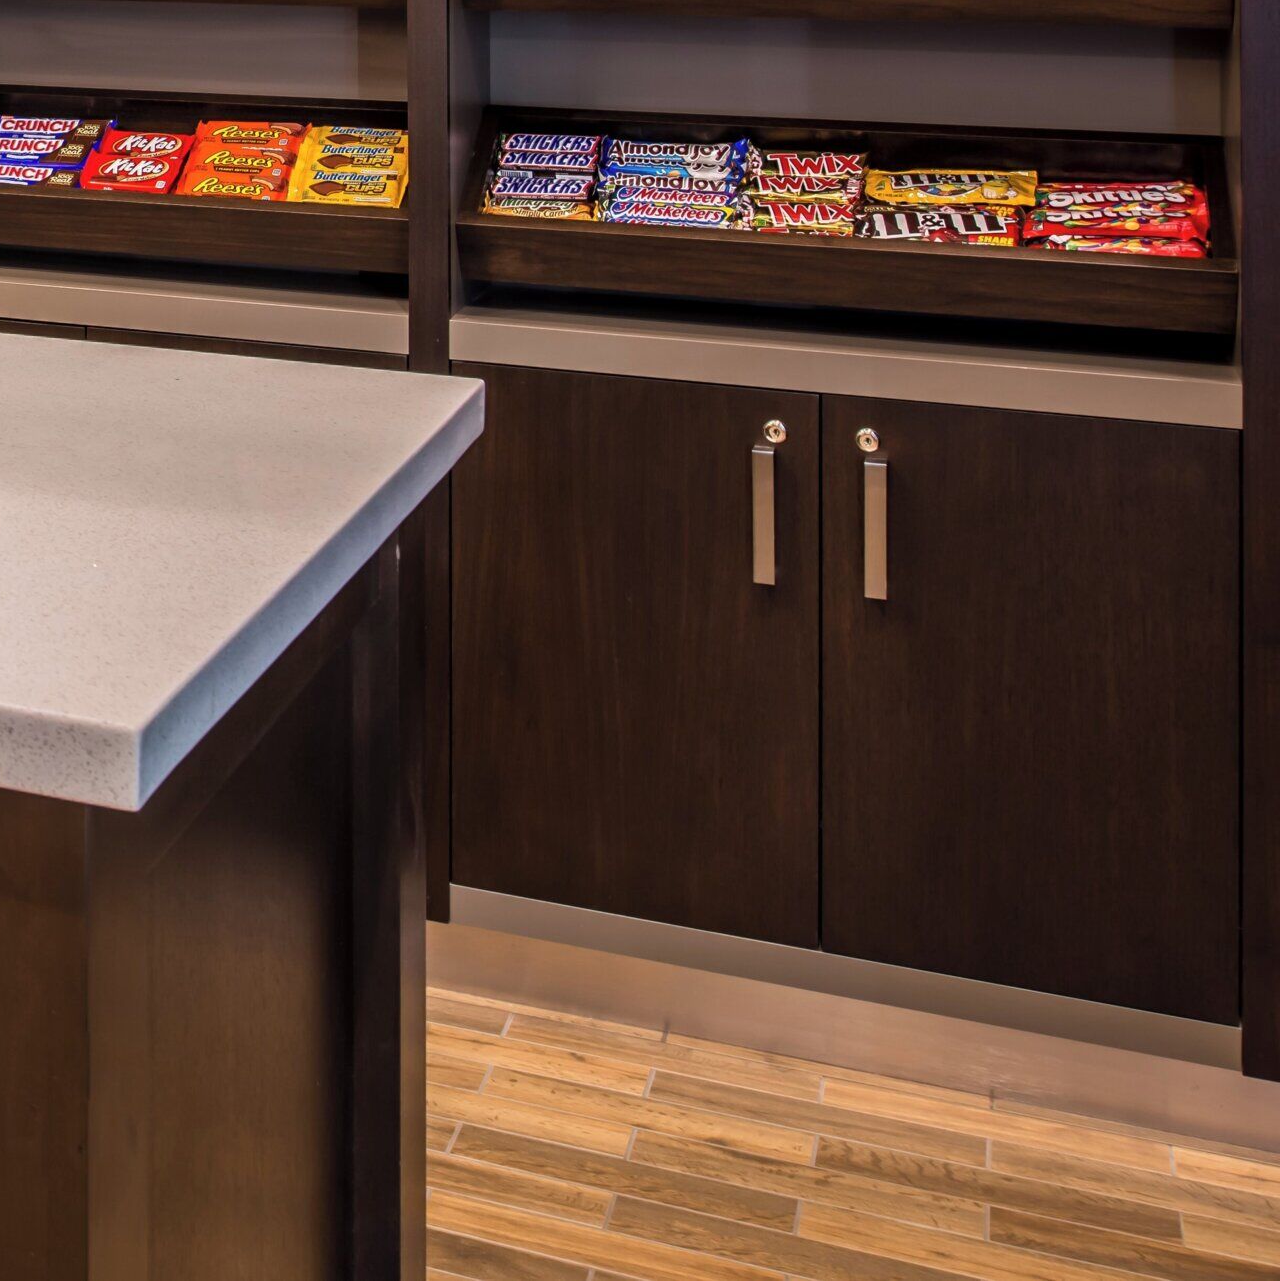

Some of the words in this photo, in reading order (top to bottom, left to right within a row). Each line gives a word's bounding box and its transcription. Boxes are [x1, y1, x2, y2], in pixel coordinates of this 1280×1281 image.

[1, 119, 74, 132] CRUNCH
[330, 126, 398, 137] Butterfinger
[509, 135, 595, 151] SNICKERS
[608, 139, 689, 158] Almond
[322, 145, 390, 155] Butterfinger
[352, 157, 392, 166] CUPS
[504, 152, 591, 166] SNICKERS
[313, 171, 383, 182] Butterfinger
[345, 184, 385, 193] CUPS
[496, 178, 584, 194] SNICKERS
[636, 188, 727, 205] Musketeers
[1048, 190, 1186, 207] Skittles
[513, 207, 540, 218] Simply
[629, 202, 722, 221] Musketeers
[977, 236, 1014, 245] SHARE
